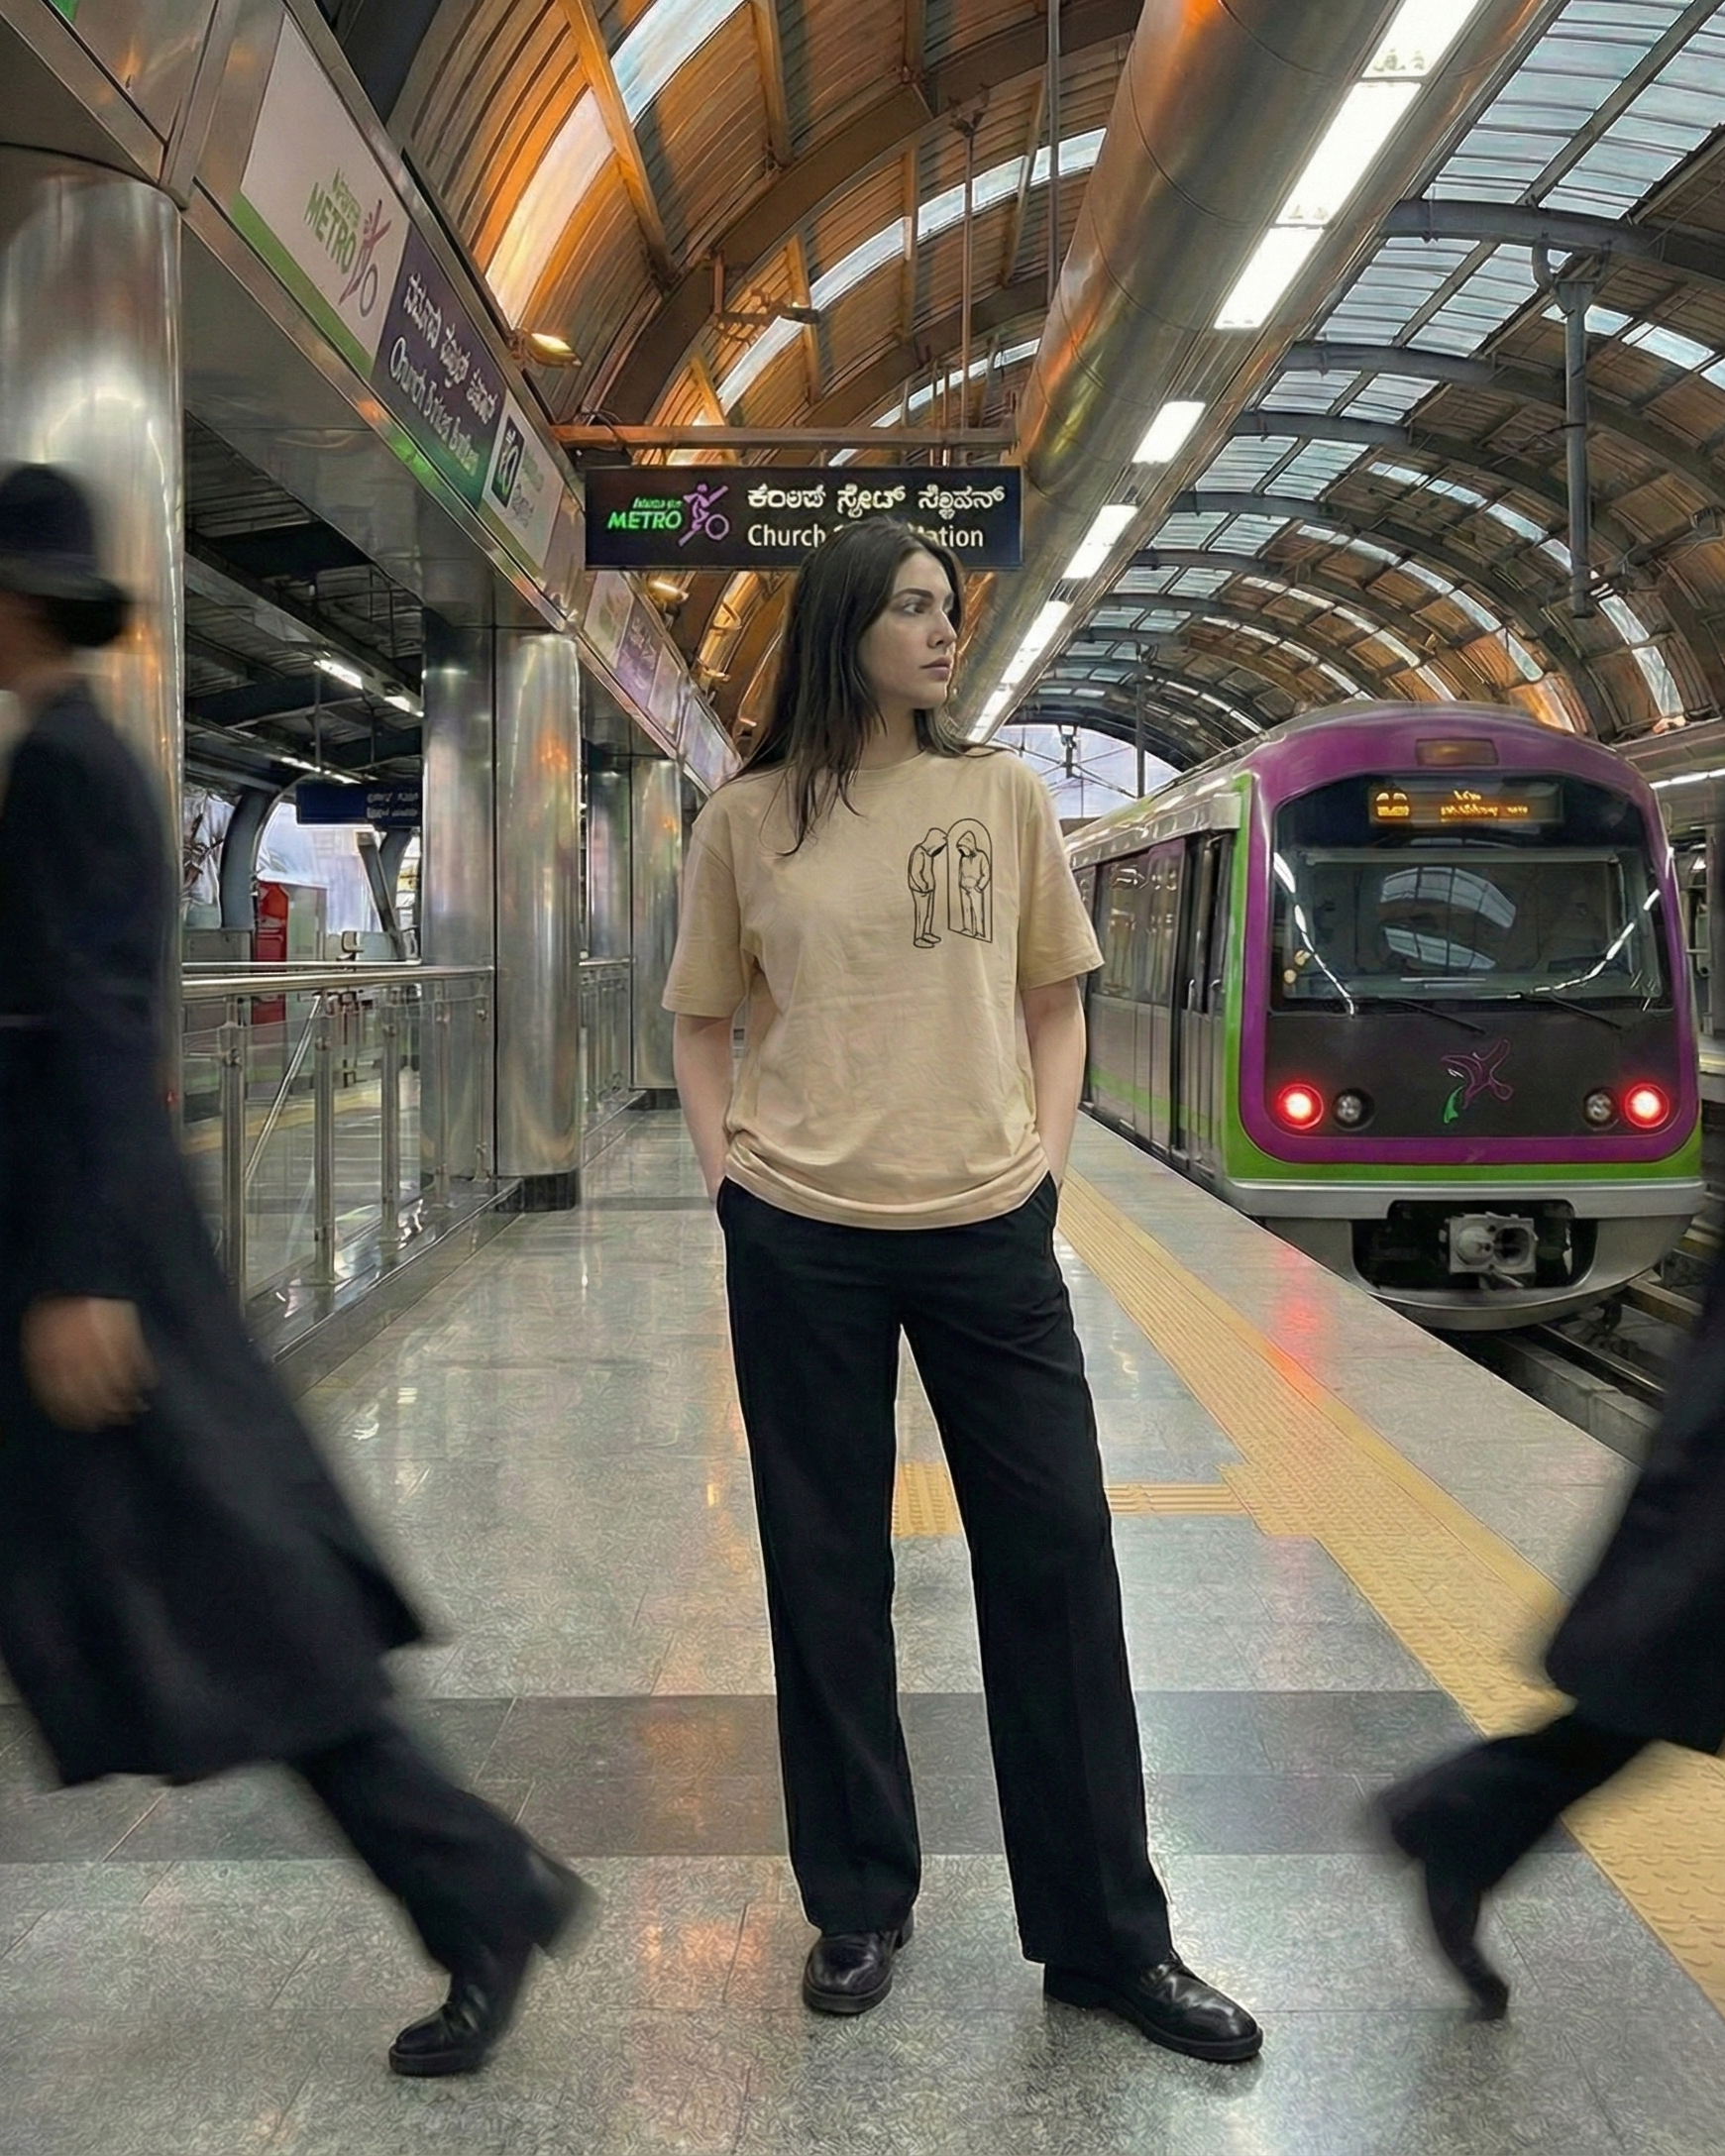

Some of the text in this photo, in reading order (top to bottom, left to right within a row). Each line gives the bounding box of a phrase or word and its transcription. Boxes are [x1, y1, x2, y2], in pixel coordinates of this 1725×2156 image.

[303, 181, 357, 274] METRO
[607, 509, 683, 529] METRO
[747, 523, 825, 548] Church
